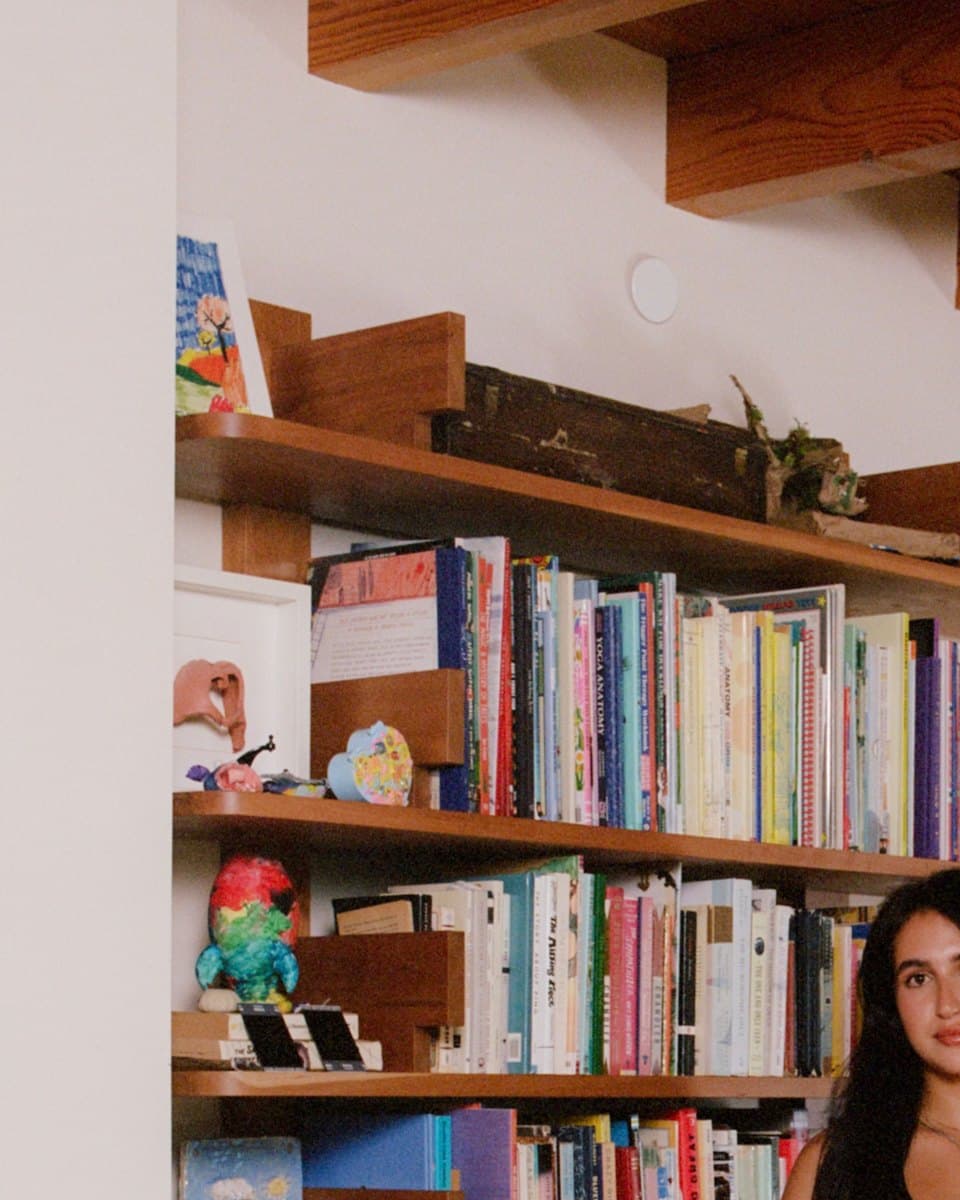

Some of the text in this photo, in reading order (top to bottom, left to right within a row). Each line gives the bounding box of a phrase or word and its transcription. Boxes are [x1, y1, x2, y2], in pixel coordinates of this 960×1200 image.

[595, 637, 604, 671] YOGA
[596, 674, 605, 735] ANATOMY
[547, 915, 558, 1008] The Missing Piece
[688, 1133, 698, 1183] GREAT
